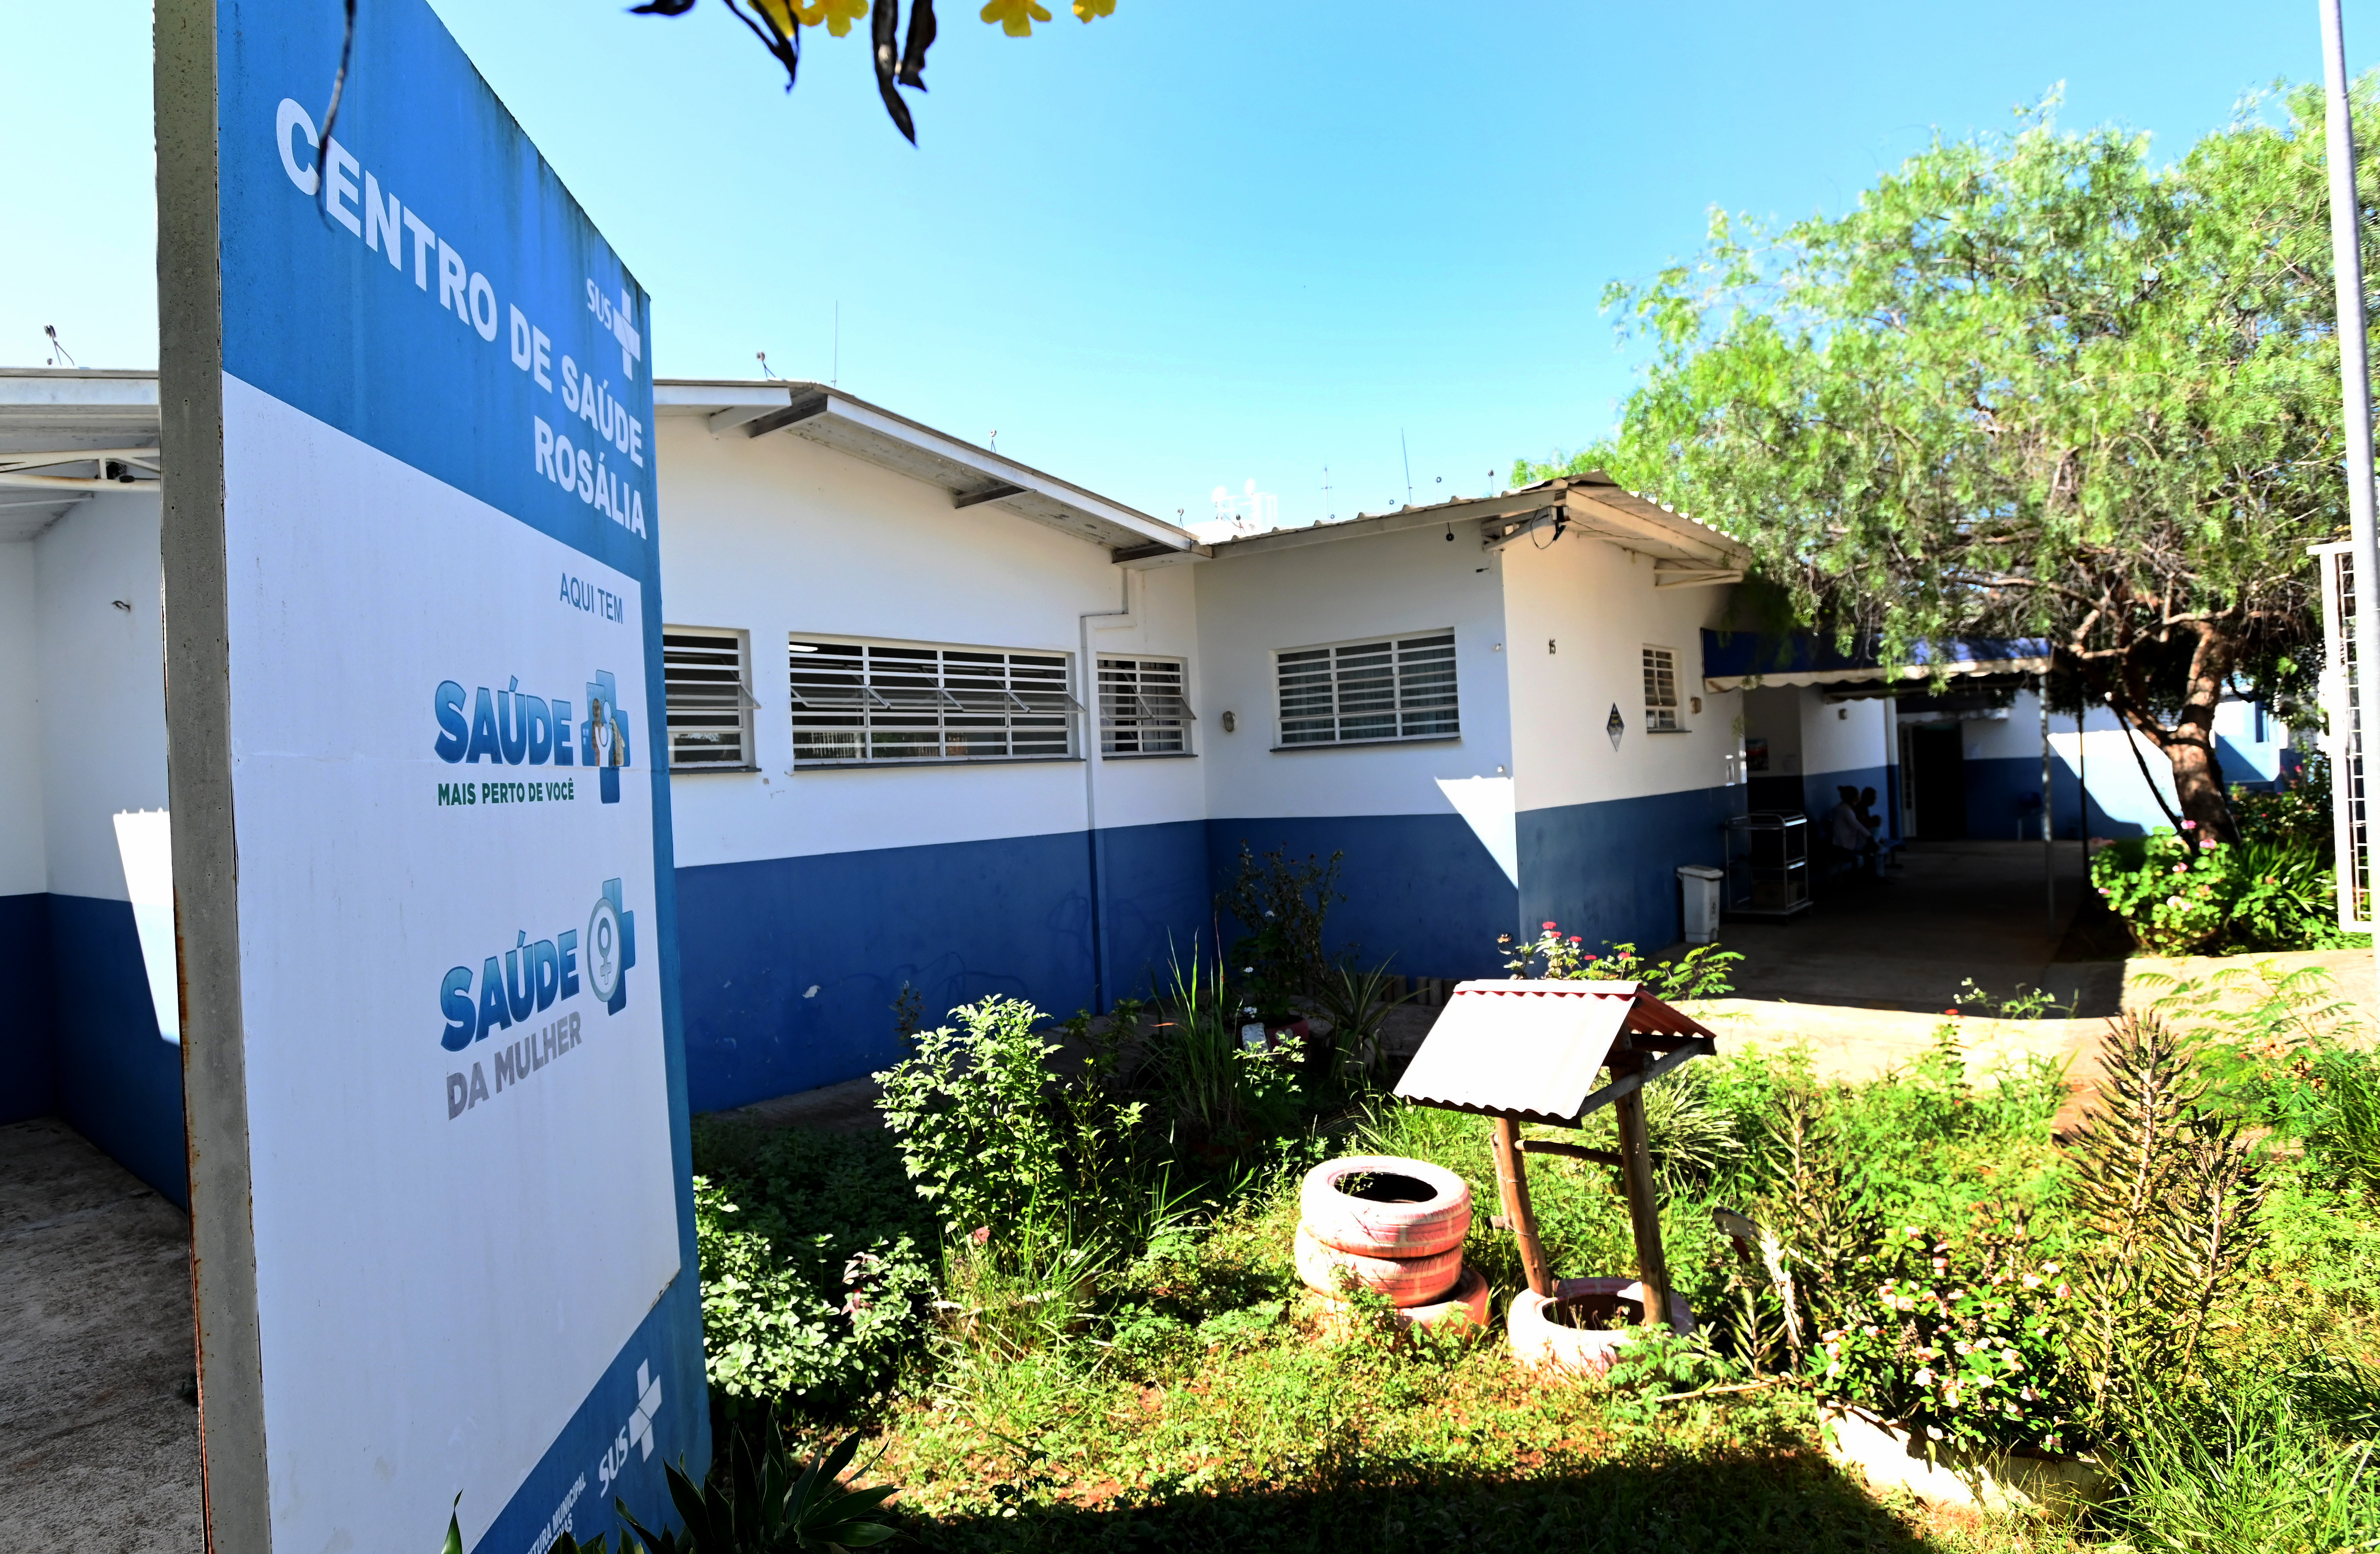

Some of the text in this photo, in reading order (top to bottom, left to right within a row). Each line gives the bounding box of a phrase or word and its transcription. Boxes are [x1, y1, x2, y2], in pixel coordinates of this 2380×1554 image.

[276, 98, 644, 469] CENTRO DE SAÚDE
[587, 278, 612, 330] SUS
[534, 415, 647, 540] ROSÁLIA
[560, 572, 623, 625] AQUI TEM
[1549, 638, 1556, 655] 15
[434, 675, 574, 766] SAÚDE
[438, 777, 574, 806] MAIS PERTO DE VOCÊ
[441, 929, 579, 1052] SAÚDE
[447, 1011, 582, 1120] DA MULHER
[599, 1425, 628, 1499] SUS
[553, 1471, 587, 1534] MUNICIPAL
